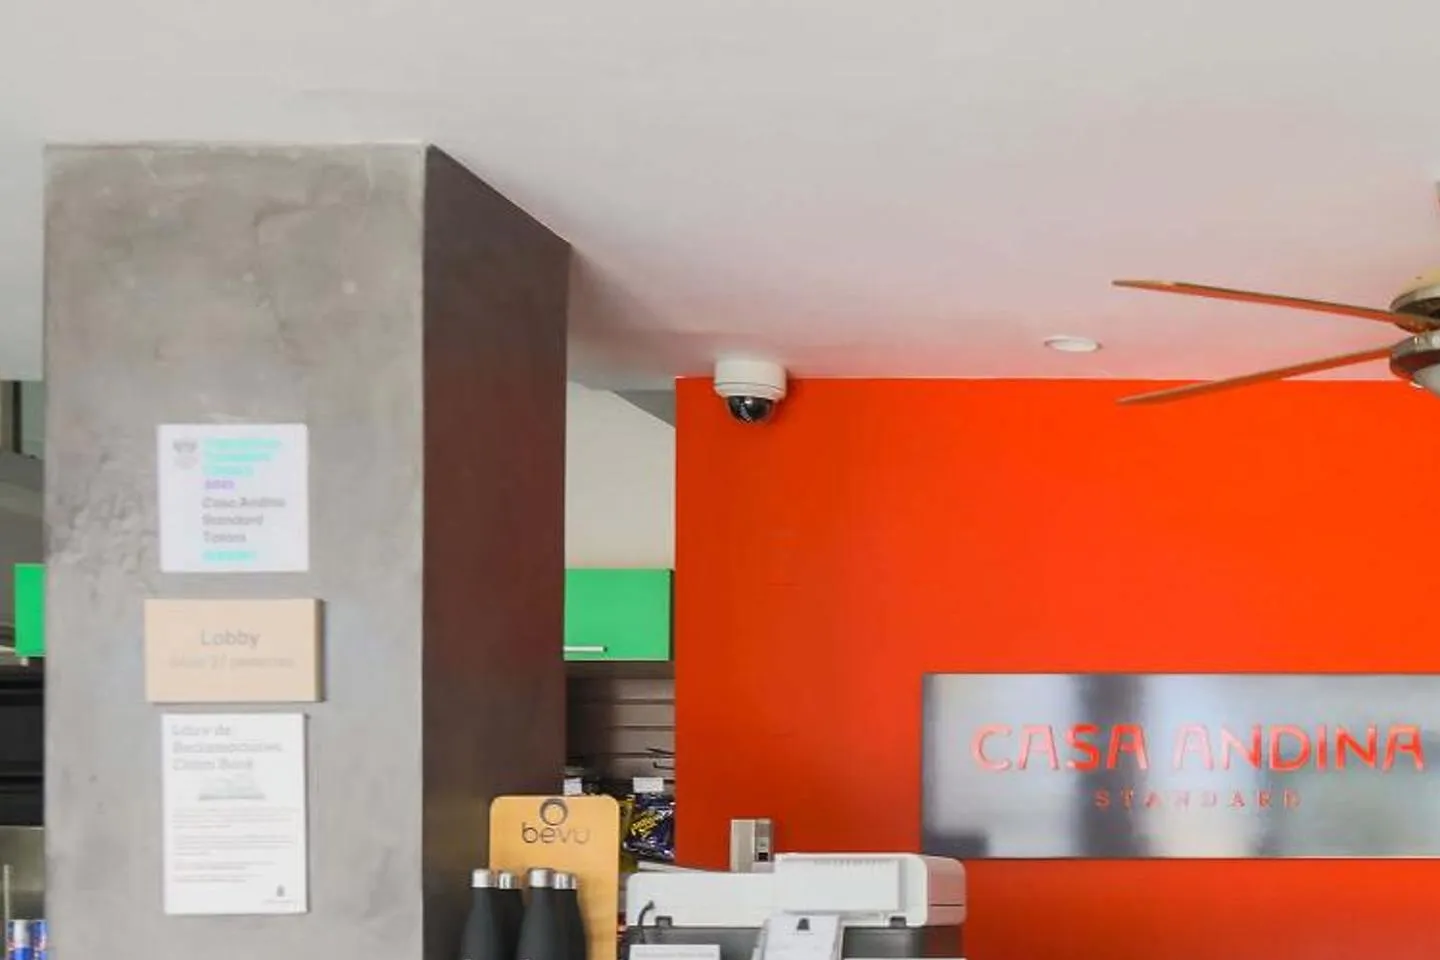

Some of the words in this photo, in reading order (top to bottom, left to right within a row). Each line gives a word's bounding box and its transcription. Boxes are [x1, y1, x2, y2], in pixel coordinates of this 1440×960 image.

[201, 628, 262, 650] Lobby
[971, 722, 1148, 771] CASA
[1173, 722, 1424, 771] ANDINA
[1096, 788, 1301, 808] STANDARD
